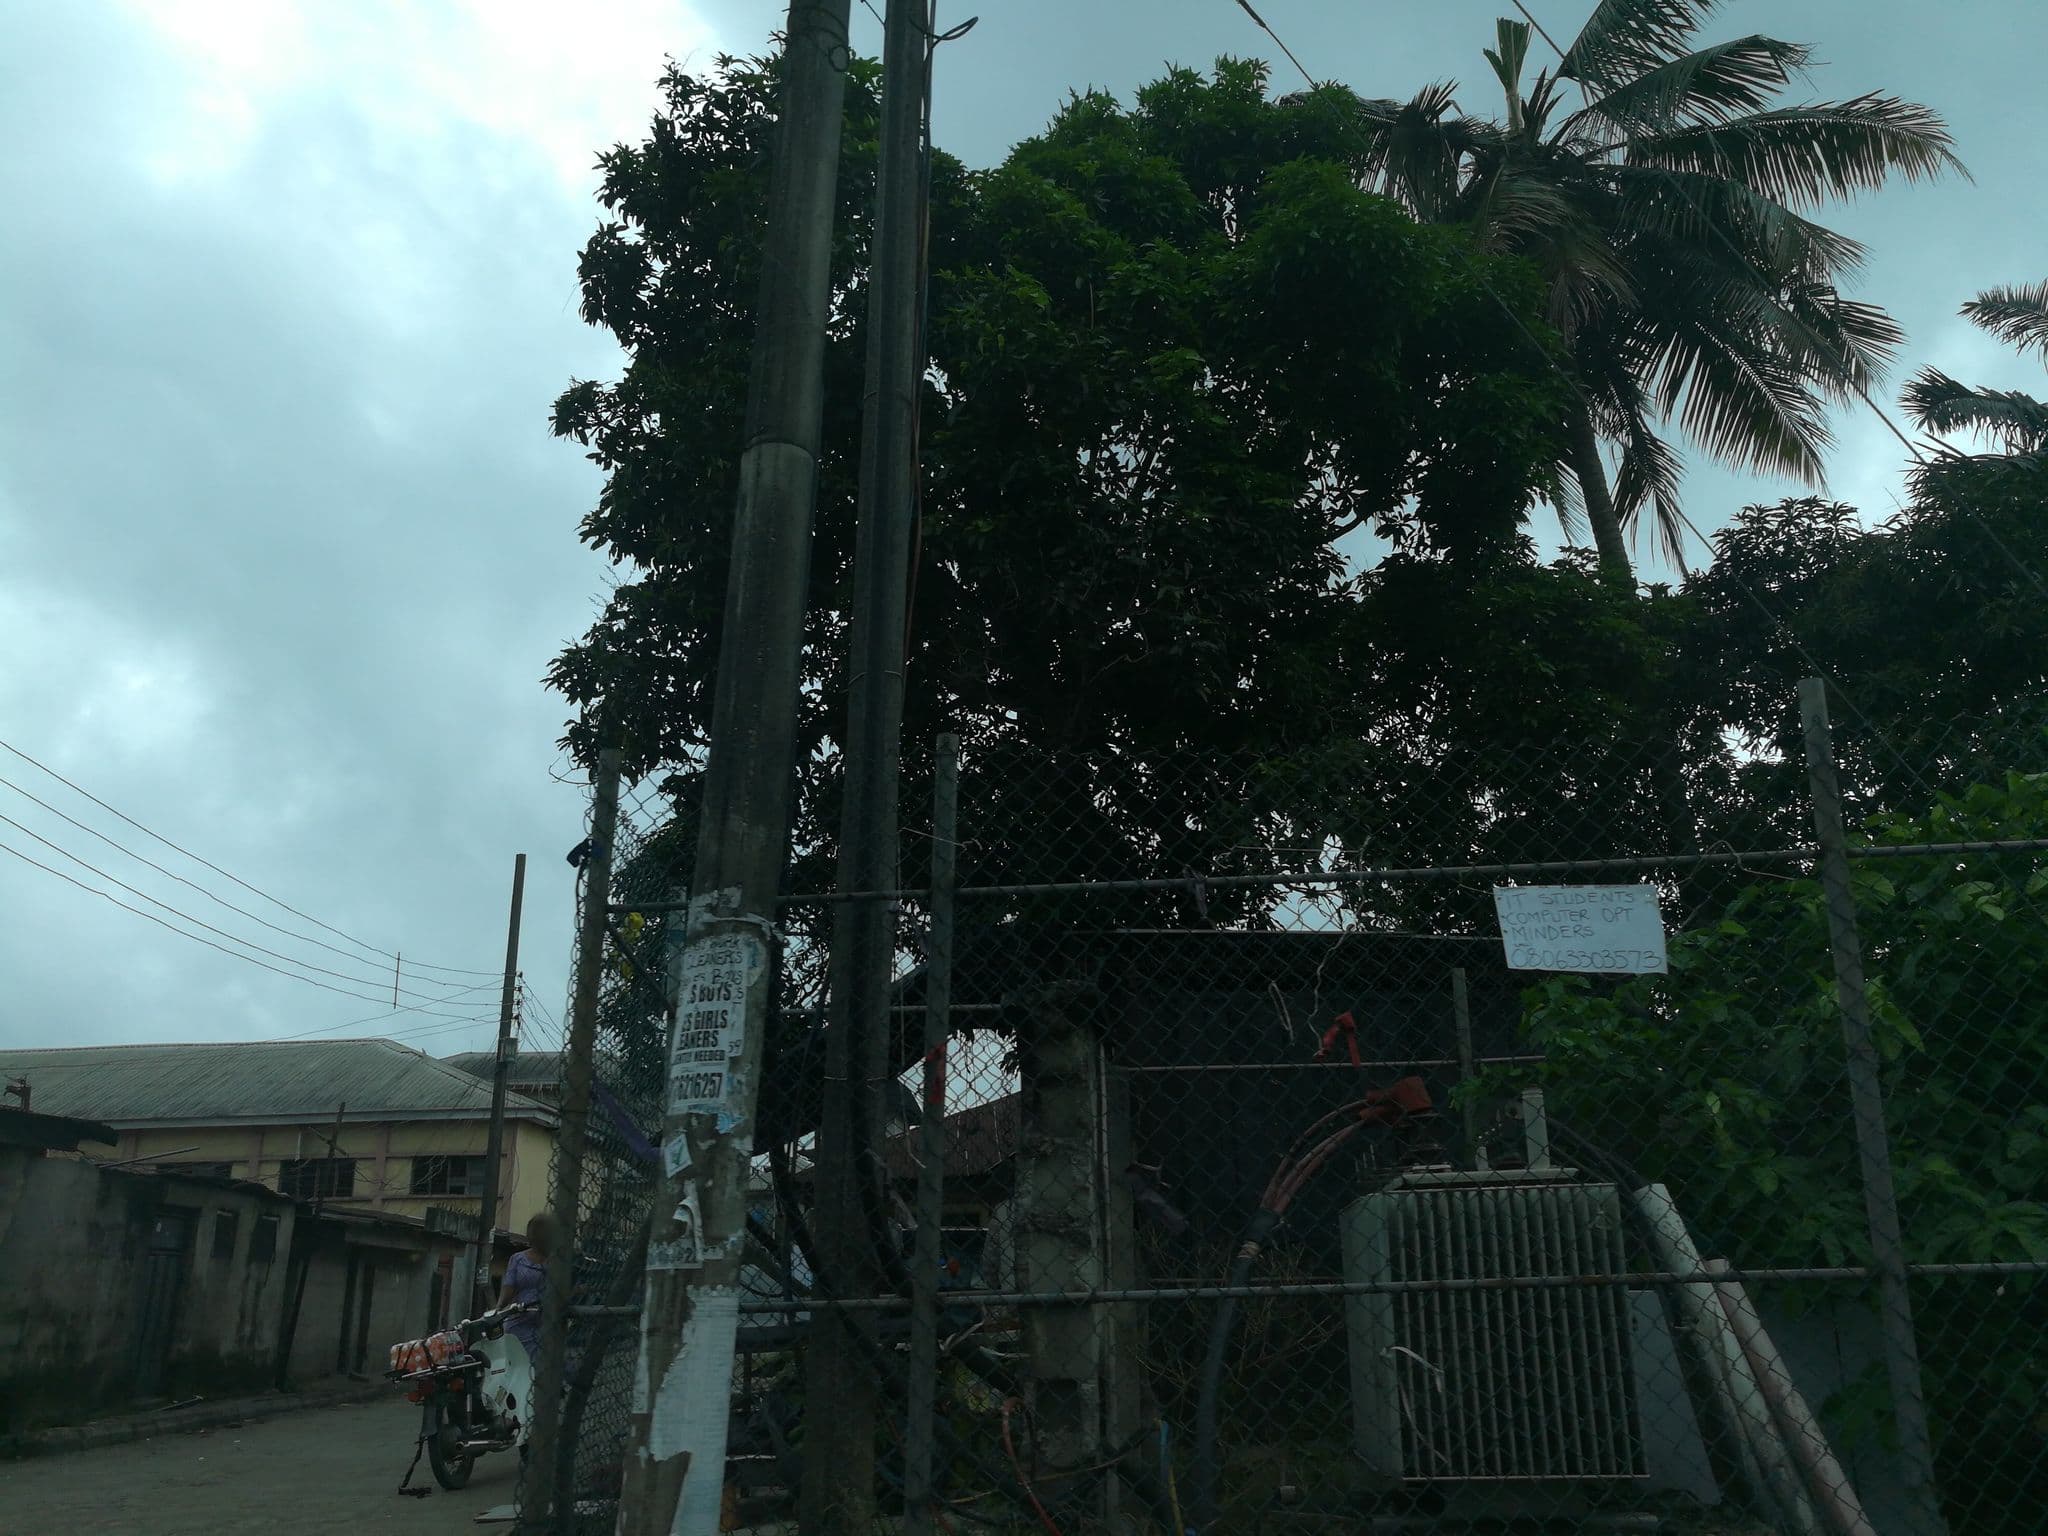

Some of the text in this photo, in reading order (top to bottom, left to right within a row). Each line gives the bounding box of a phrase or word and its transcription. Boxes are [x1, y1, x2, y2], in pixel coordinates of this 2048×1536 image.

[1505, 891, 1635, 909] IT STUDENTS
[1505, 907, 1633, 925] COMPUTER OPT
[1511, 924, 1595, 941] MINDERS
[694, 1009, 728, 1030] GIRLS
